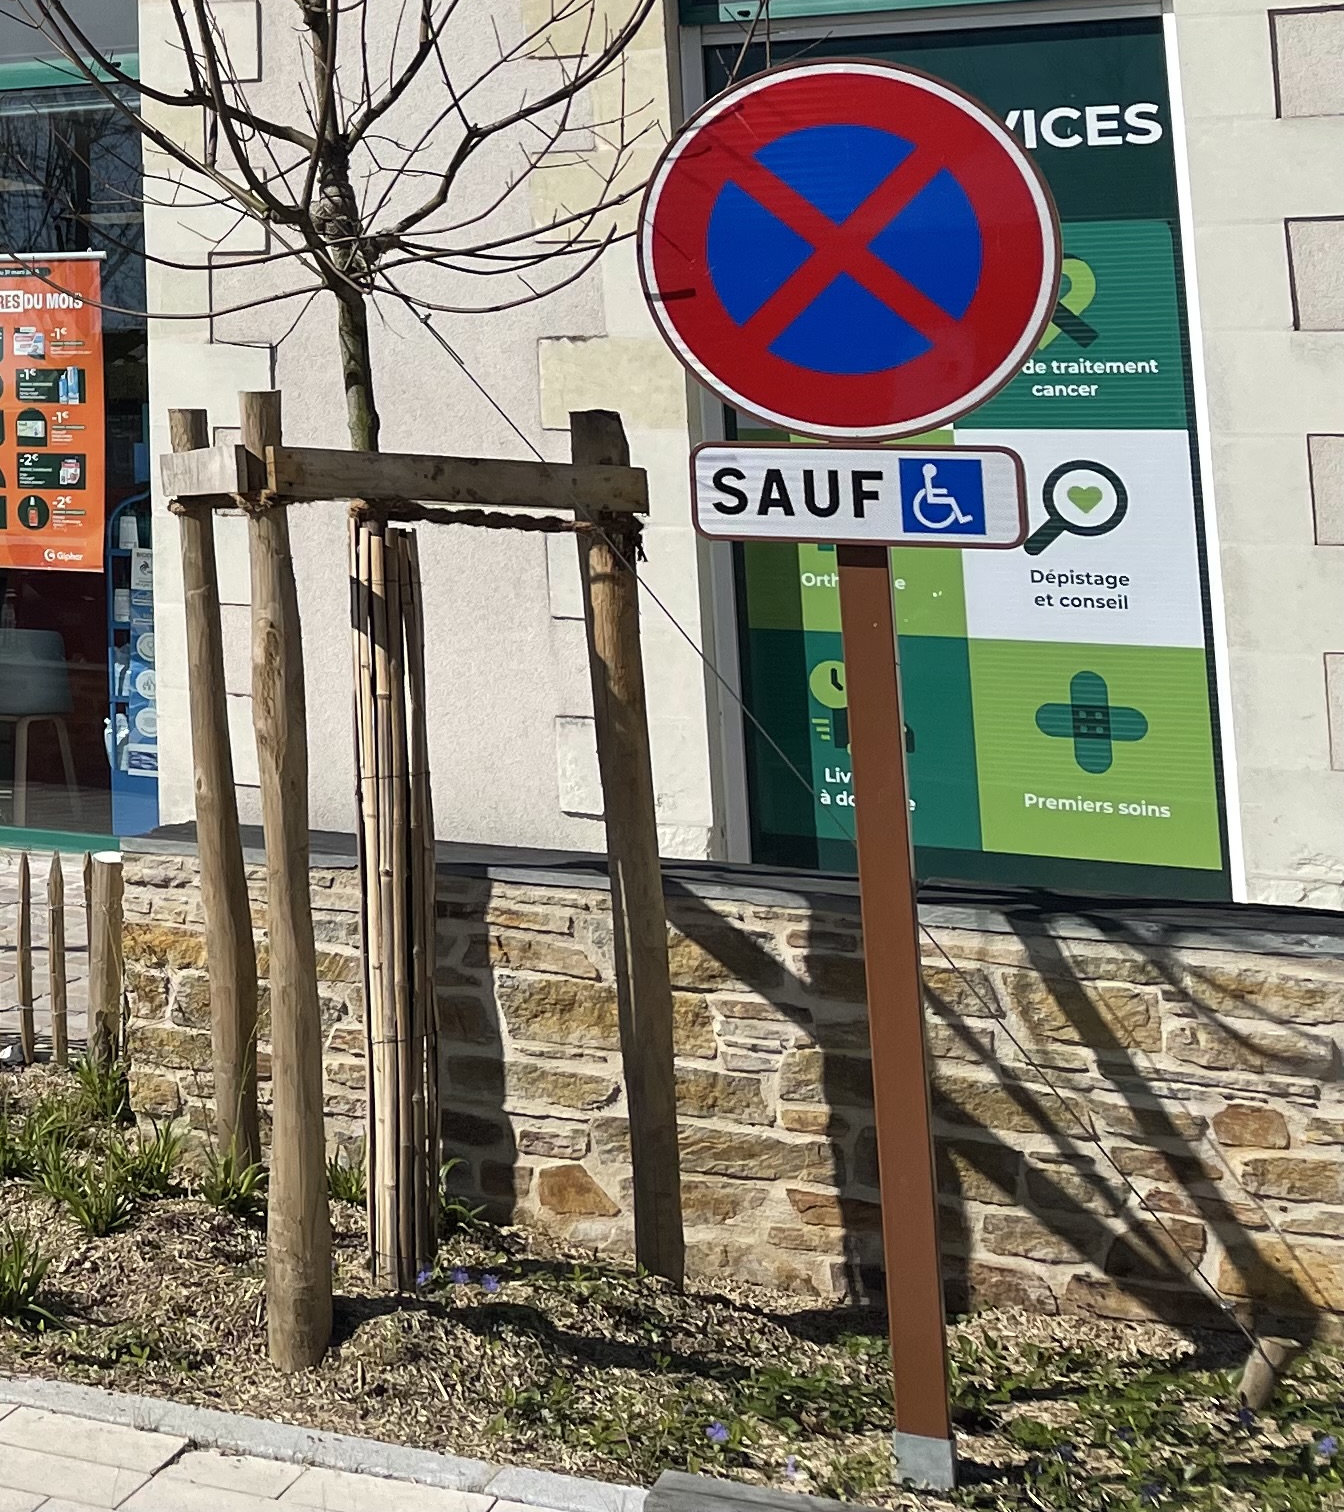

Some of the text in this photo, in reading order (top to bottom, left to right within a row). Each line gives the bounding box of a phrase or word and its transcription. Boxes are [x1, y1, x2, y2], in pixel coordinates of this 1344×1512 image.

[23, 293, 44, 310] DU
[45, 292, 83, 309] MOIS
[1022, 357, 1159, 375] de traitement
[1031, 384, 1099, 397] cancer
[711, 466, 884, 519] SAUF
[1030, 568, 1130, 589] Dépistage
[1034, 593, 1129, 610] et conseil
[820, 788, 832, 805] à
[1023, 792, 1172, 818] Premiers soins
